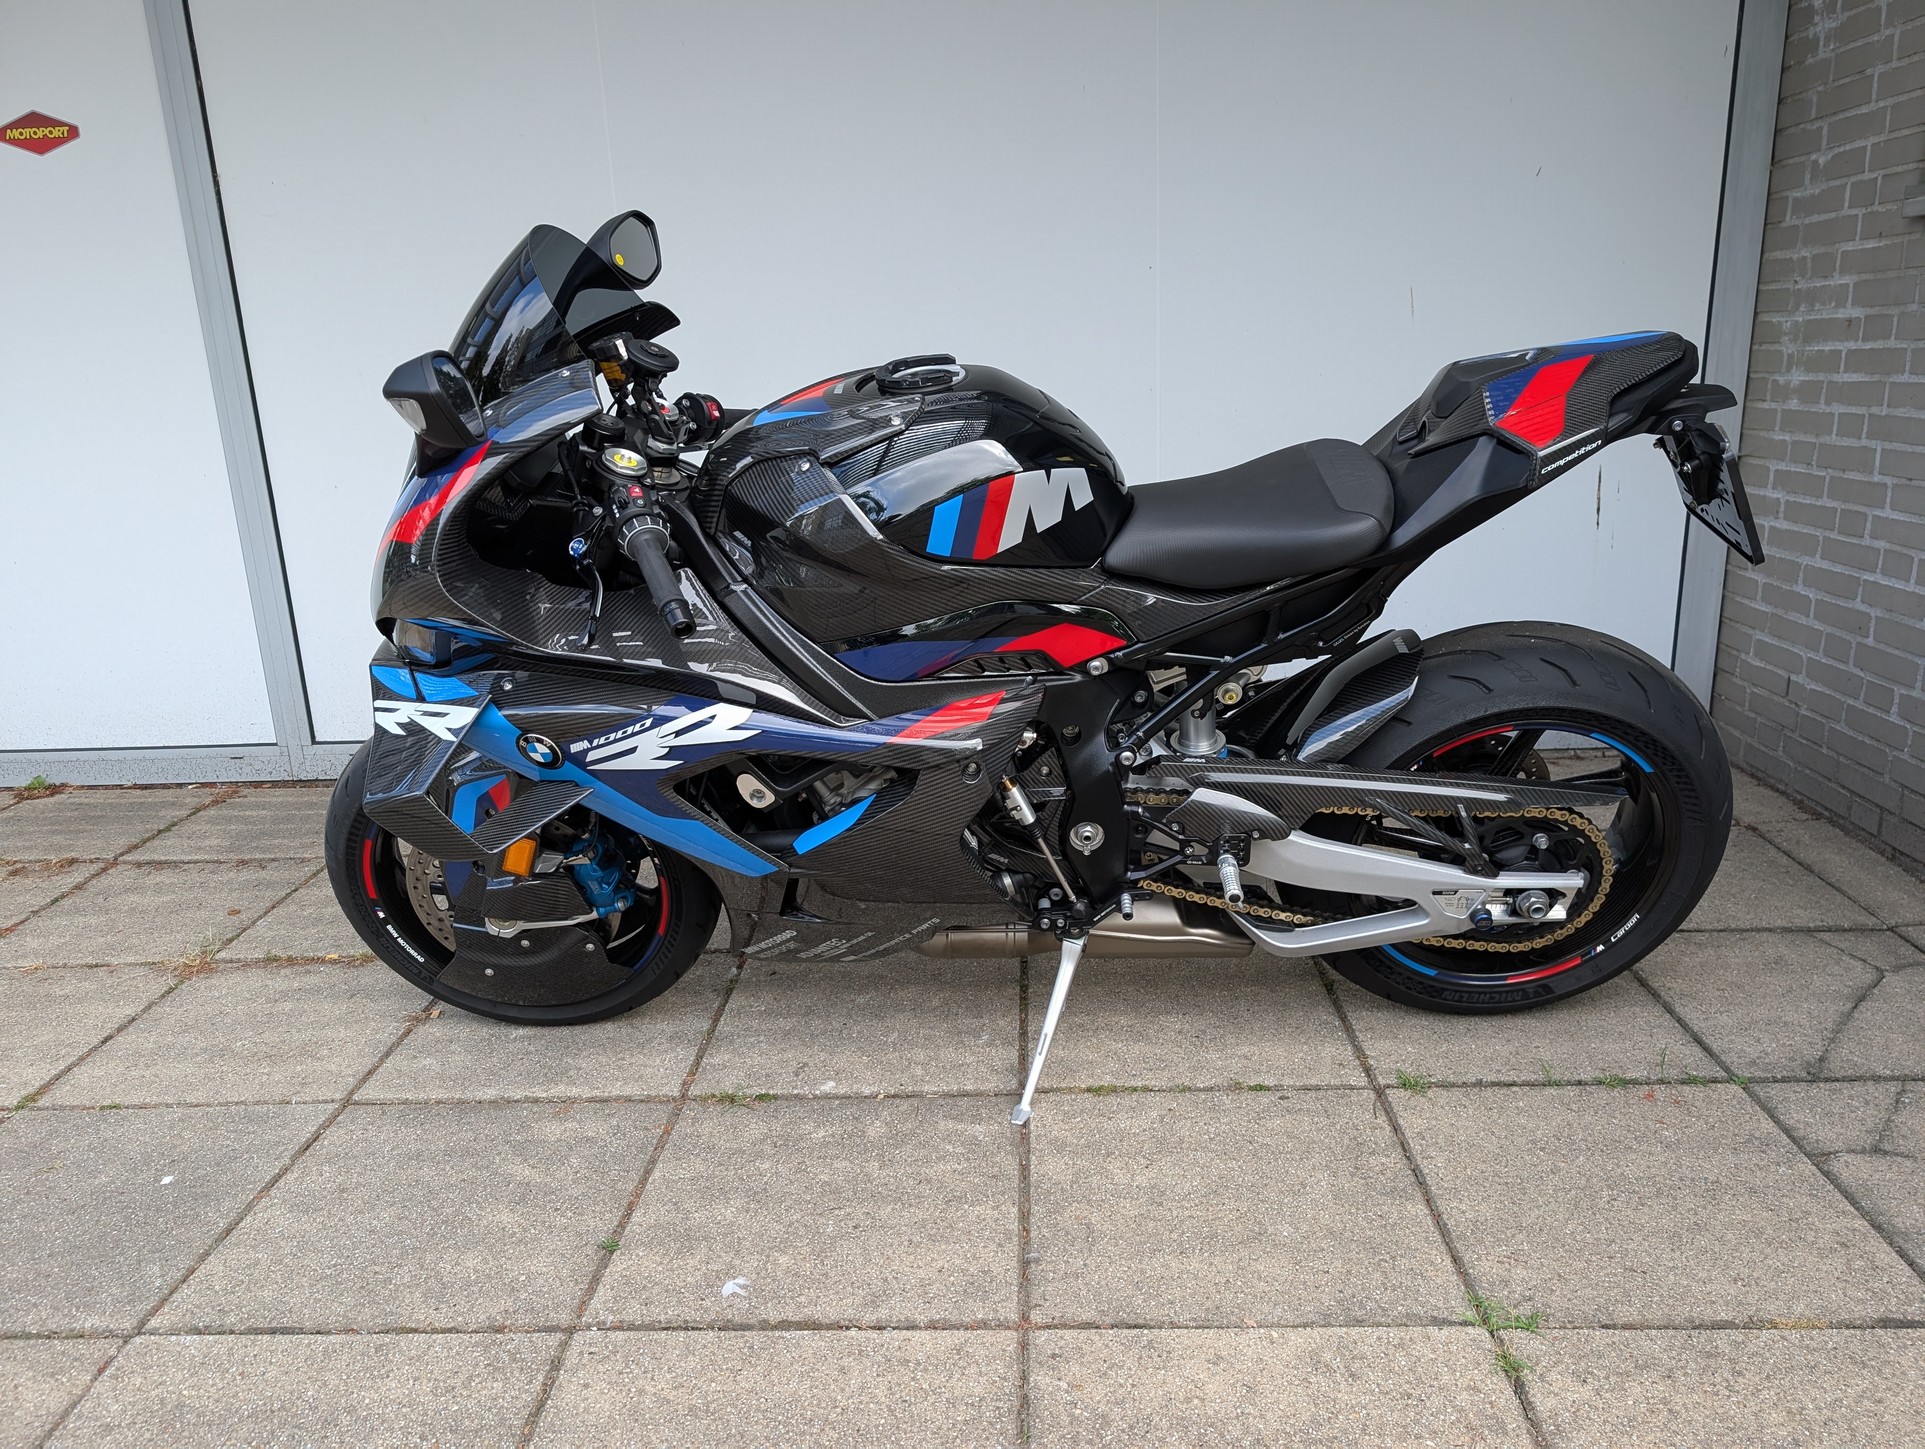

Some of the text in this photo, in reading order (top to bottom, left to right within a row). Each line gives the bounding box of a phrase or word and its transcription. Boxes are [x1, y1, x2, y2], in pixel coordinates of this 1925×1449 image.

[6, 126, 69, 140] MOTOPORT
[1541, 439, 1602, 474] competition
[373, 700, 480, 741] RR
[586, 702, 762, 770] RR
[911, 917, 940, 935] PARTS
[1610, 912, 1640, 942] Carbon
[386, 924, 425, 963] BMW MOTORRAD
[1441, 989, 1523, 1003] MICHELIN
